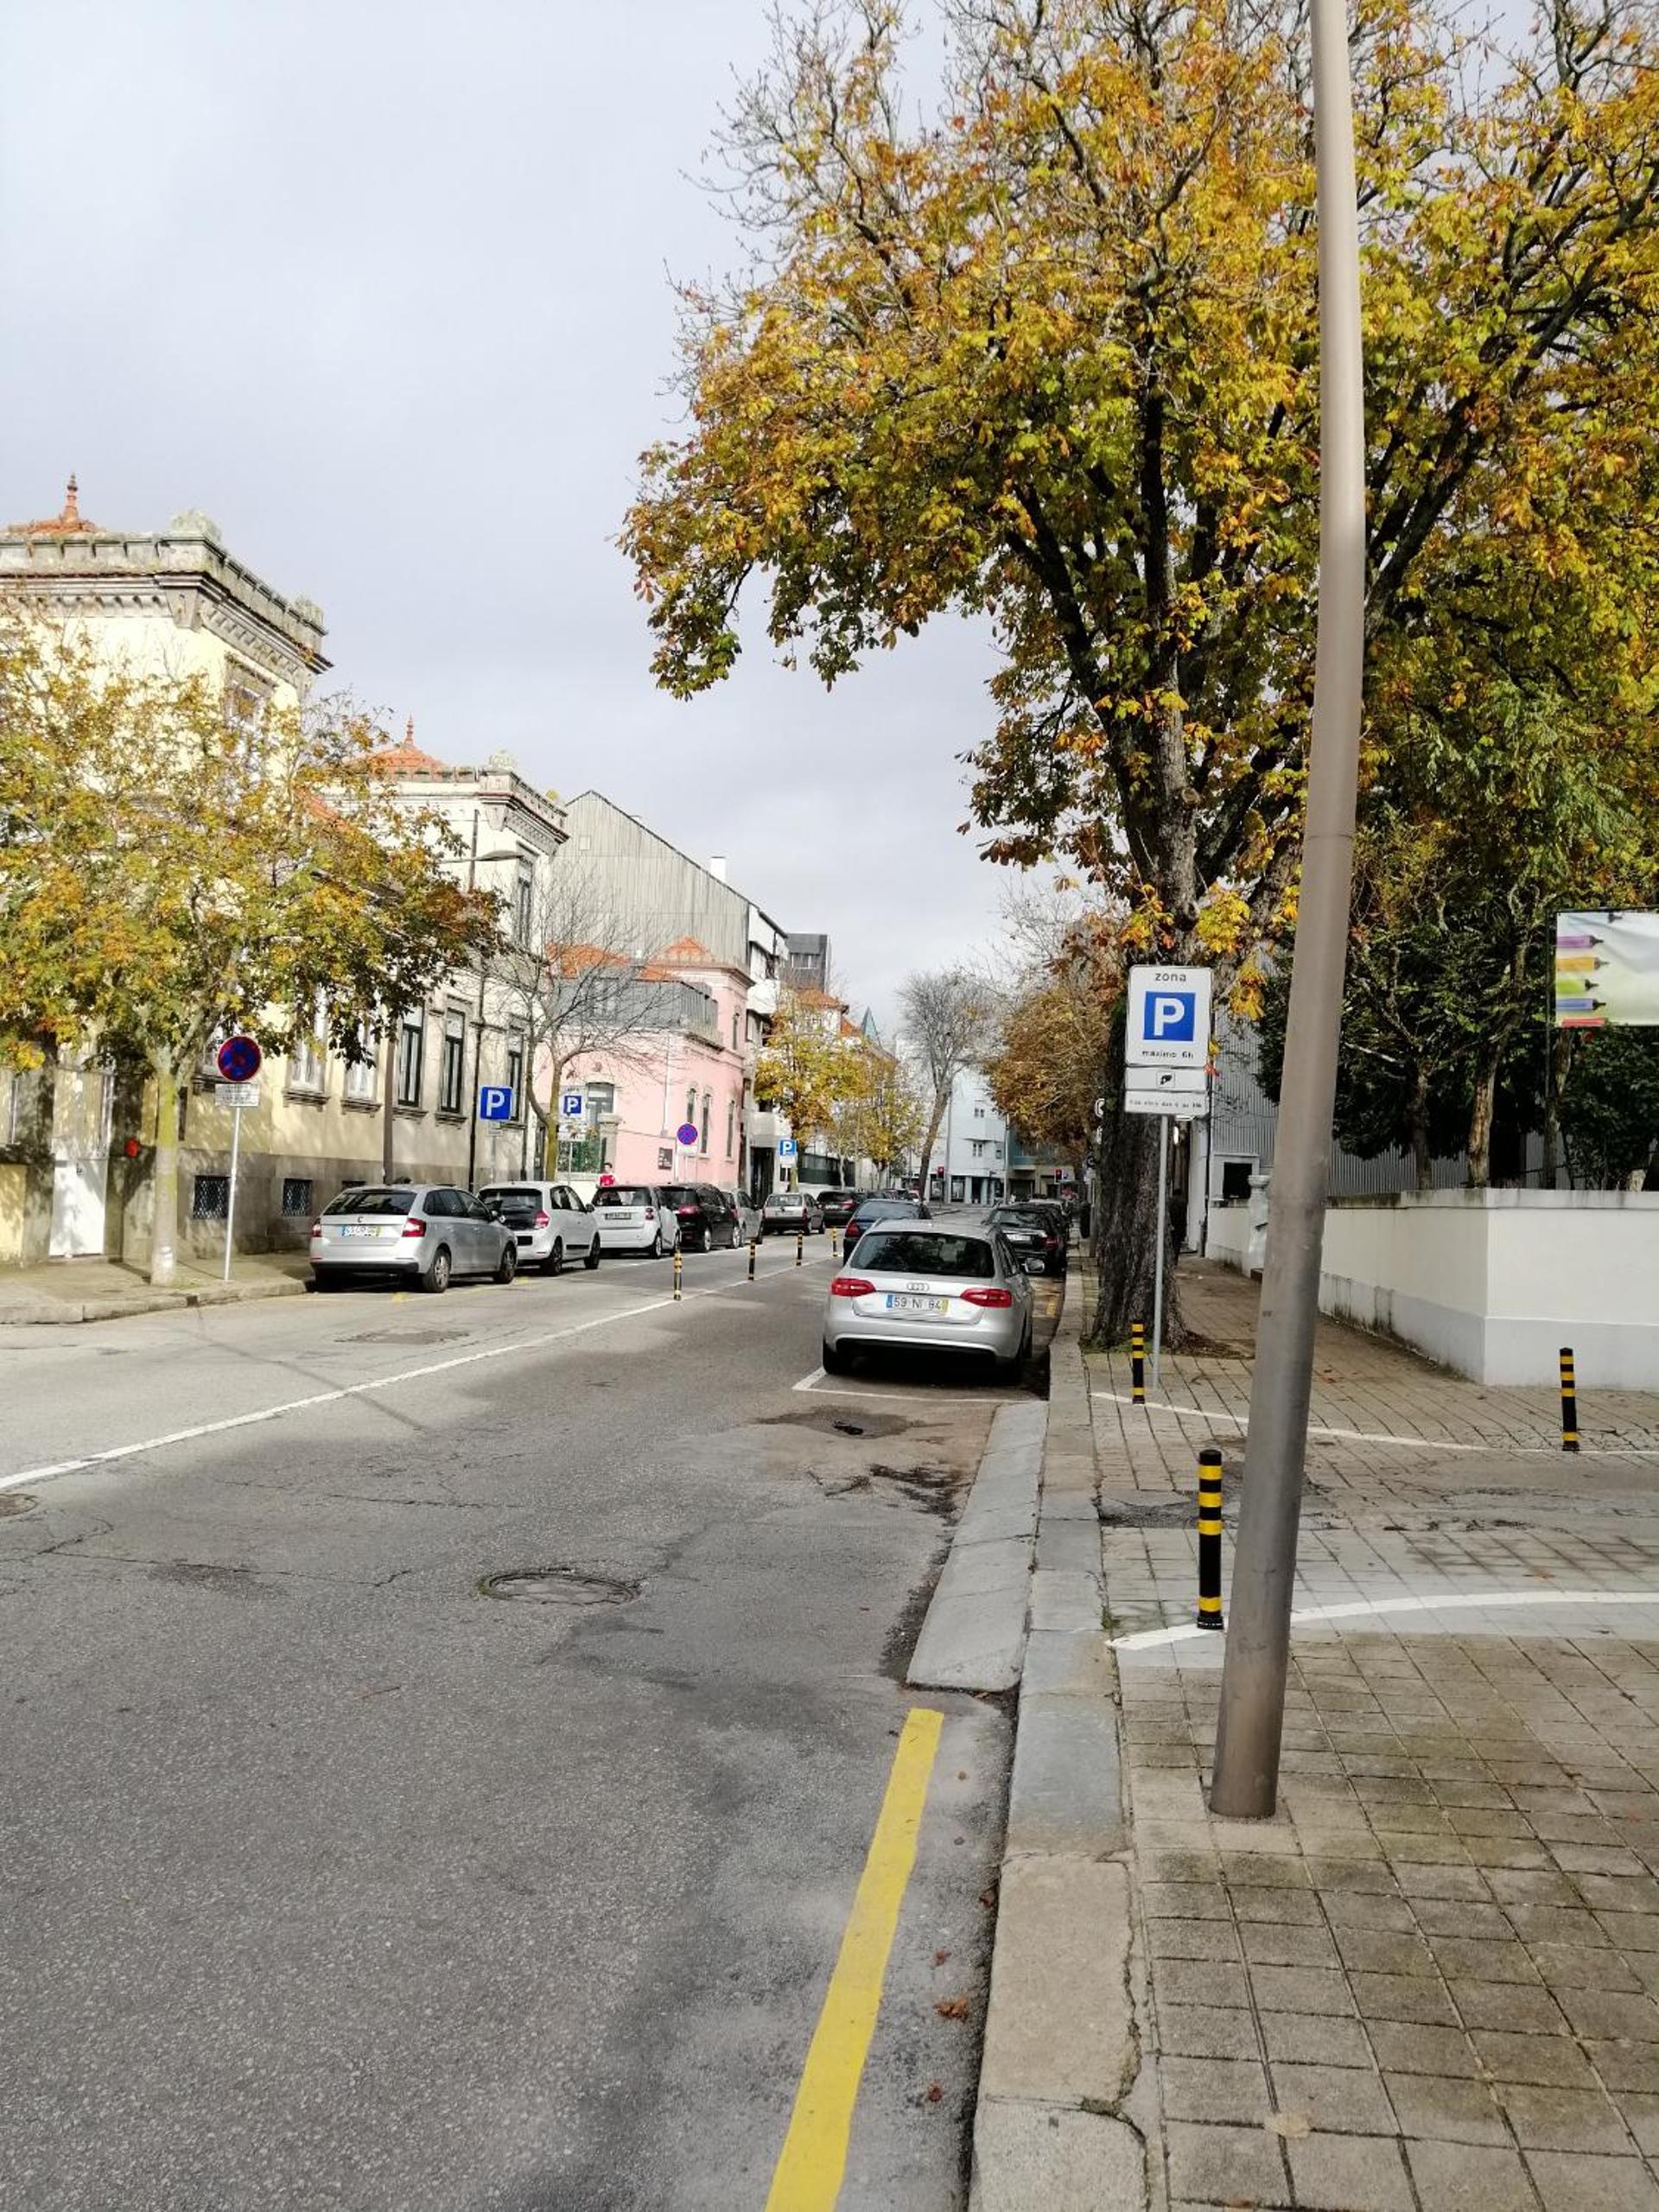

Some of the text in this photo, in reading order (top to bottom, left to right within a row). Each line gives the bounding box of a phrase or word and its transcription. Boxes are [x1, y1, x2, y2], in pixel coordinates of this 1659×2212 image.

[1154, 972, 1187, 982] zona
[1154, 997, 1185, 1036] P
[486, 1090, 505, 1116] P
[567, 1096, 579, 1113] P
[782, 1141, 793, 1155] P
